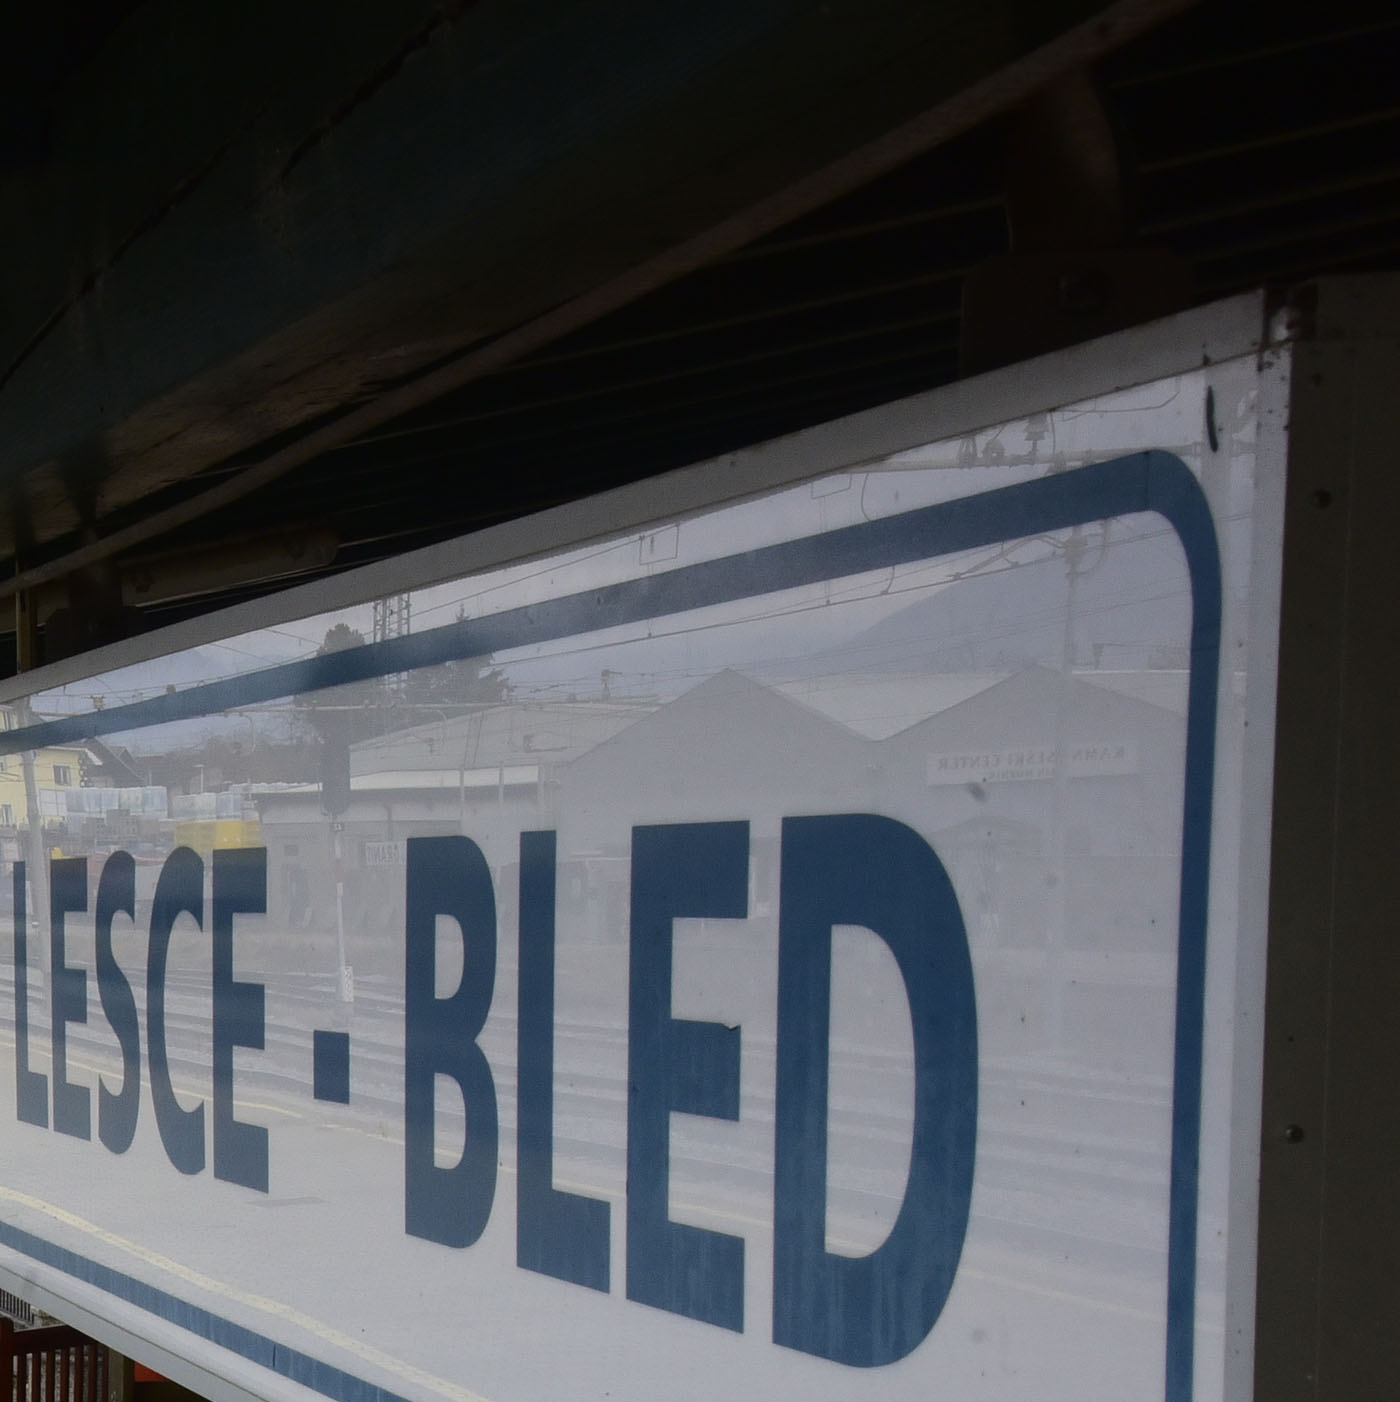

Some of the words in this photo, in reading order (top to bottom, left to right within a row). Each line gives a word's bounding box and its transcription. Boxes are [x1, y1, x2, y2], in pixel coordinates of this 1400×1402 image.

[12, 846, 270, 1194] LESCE
[313, 1029, 350, 1106] -
[404, 812, 980, 1369] BLED
